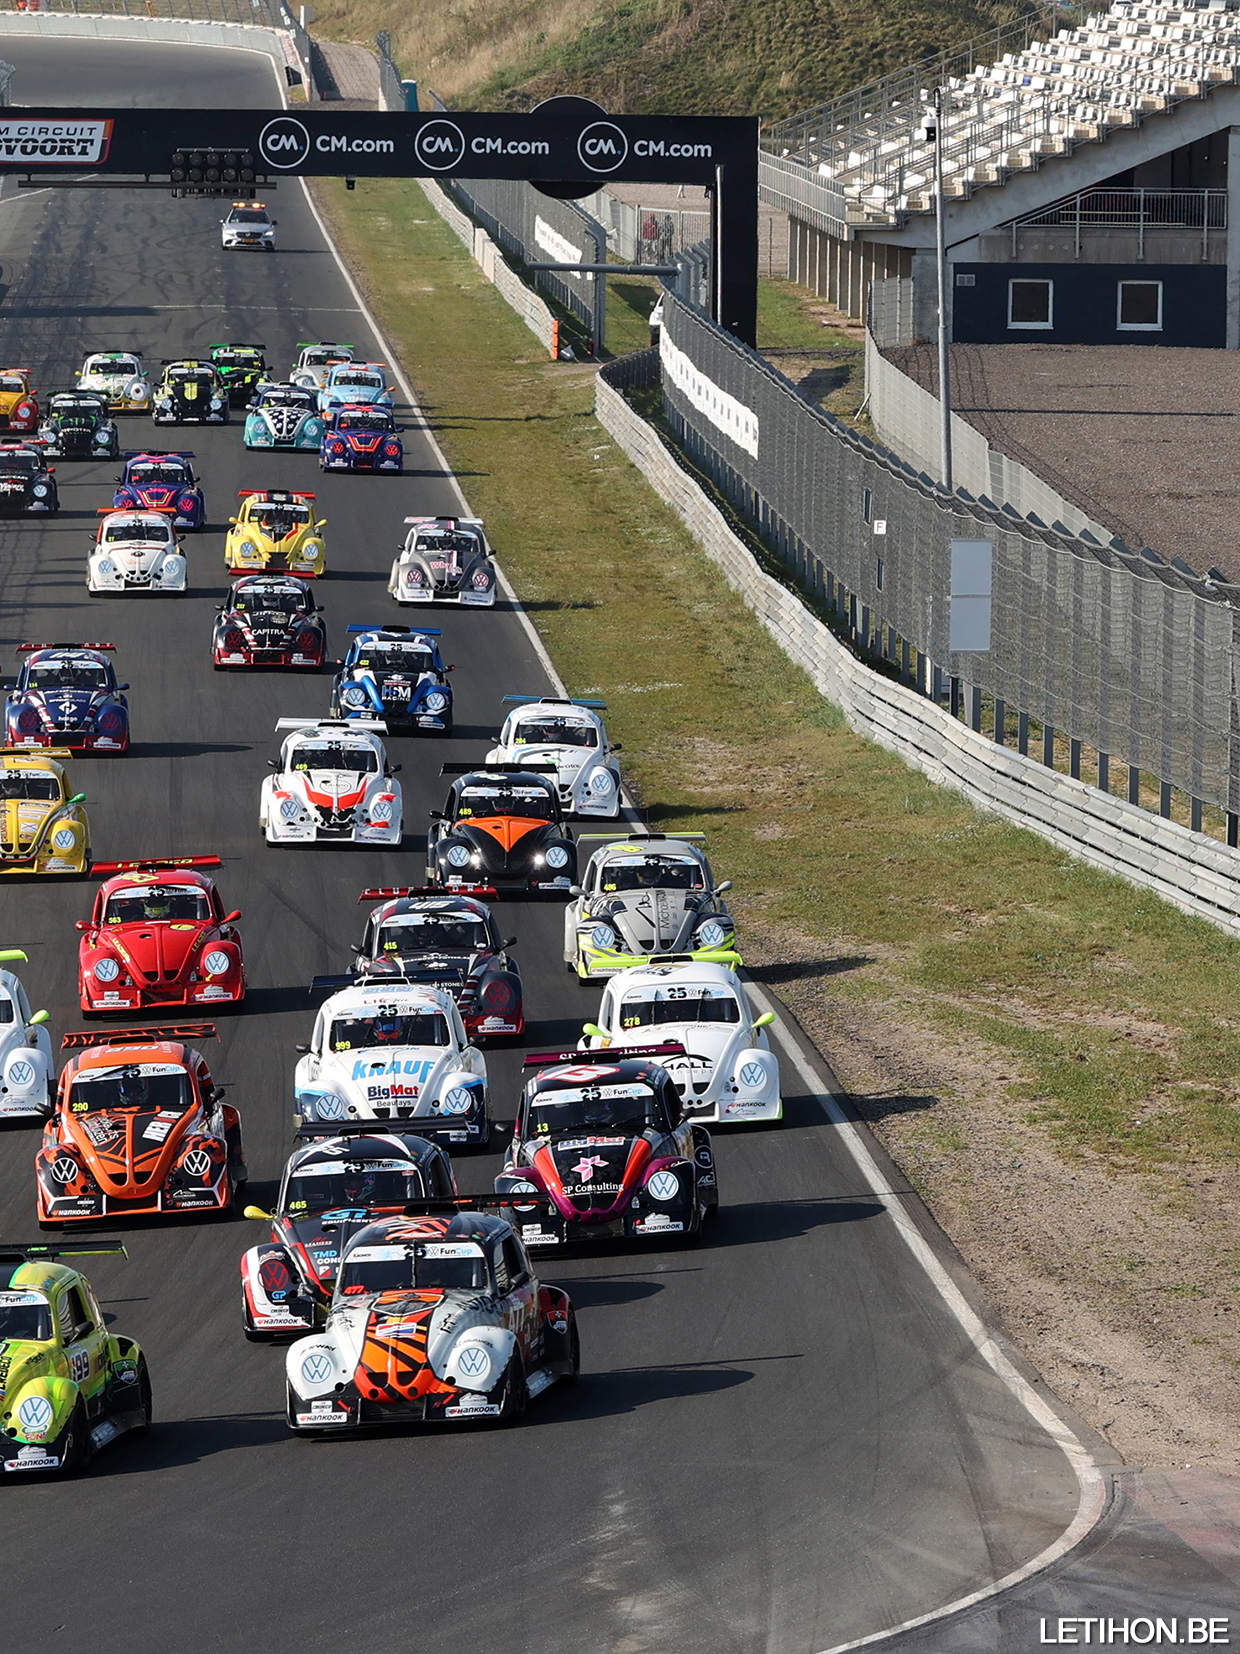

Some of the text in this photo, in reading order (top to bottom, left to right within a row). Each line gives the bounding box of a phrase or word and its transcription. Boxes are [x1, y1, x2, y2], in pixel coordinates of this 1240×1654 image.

[17, 127, 97, 136] CIRCUIT
[316, 135, 394, 153] CM.com
[471, 136, 549, 155] CM.com
[634, 139, 712, 158] CM.com
[876, 521, 884, 532] F
[390, 643, 403, 652] 25
[327, 741, 342, 750] 25
[6, 770, 22, 779] 25
[667, 987, 688, 999] 25
[378, 1004, 398, 1016] 25
[624, 1017, 641, 1027] 278
[335, 1041, 351, 1049] 999
[152, 1065, 180, 1073] FunCup
[352, 1059, 436, 1083] KNAUF
[367, 1084, 419, 1100] BigMat
[580, 1087, 643, 1100] 25 FunCup
[72, 1103, 89, 1112] 290
[537, 1123, 549, 1132] 13
[562, 1183, 624, 1194] SP Consulting
[289, 1201, 307, 1210] 465
[440, 1247, 473, 1256] FunCup
[344, 1286, 366, 1294] 477
[271, 1291, 287, 1299] GP
